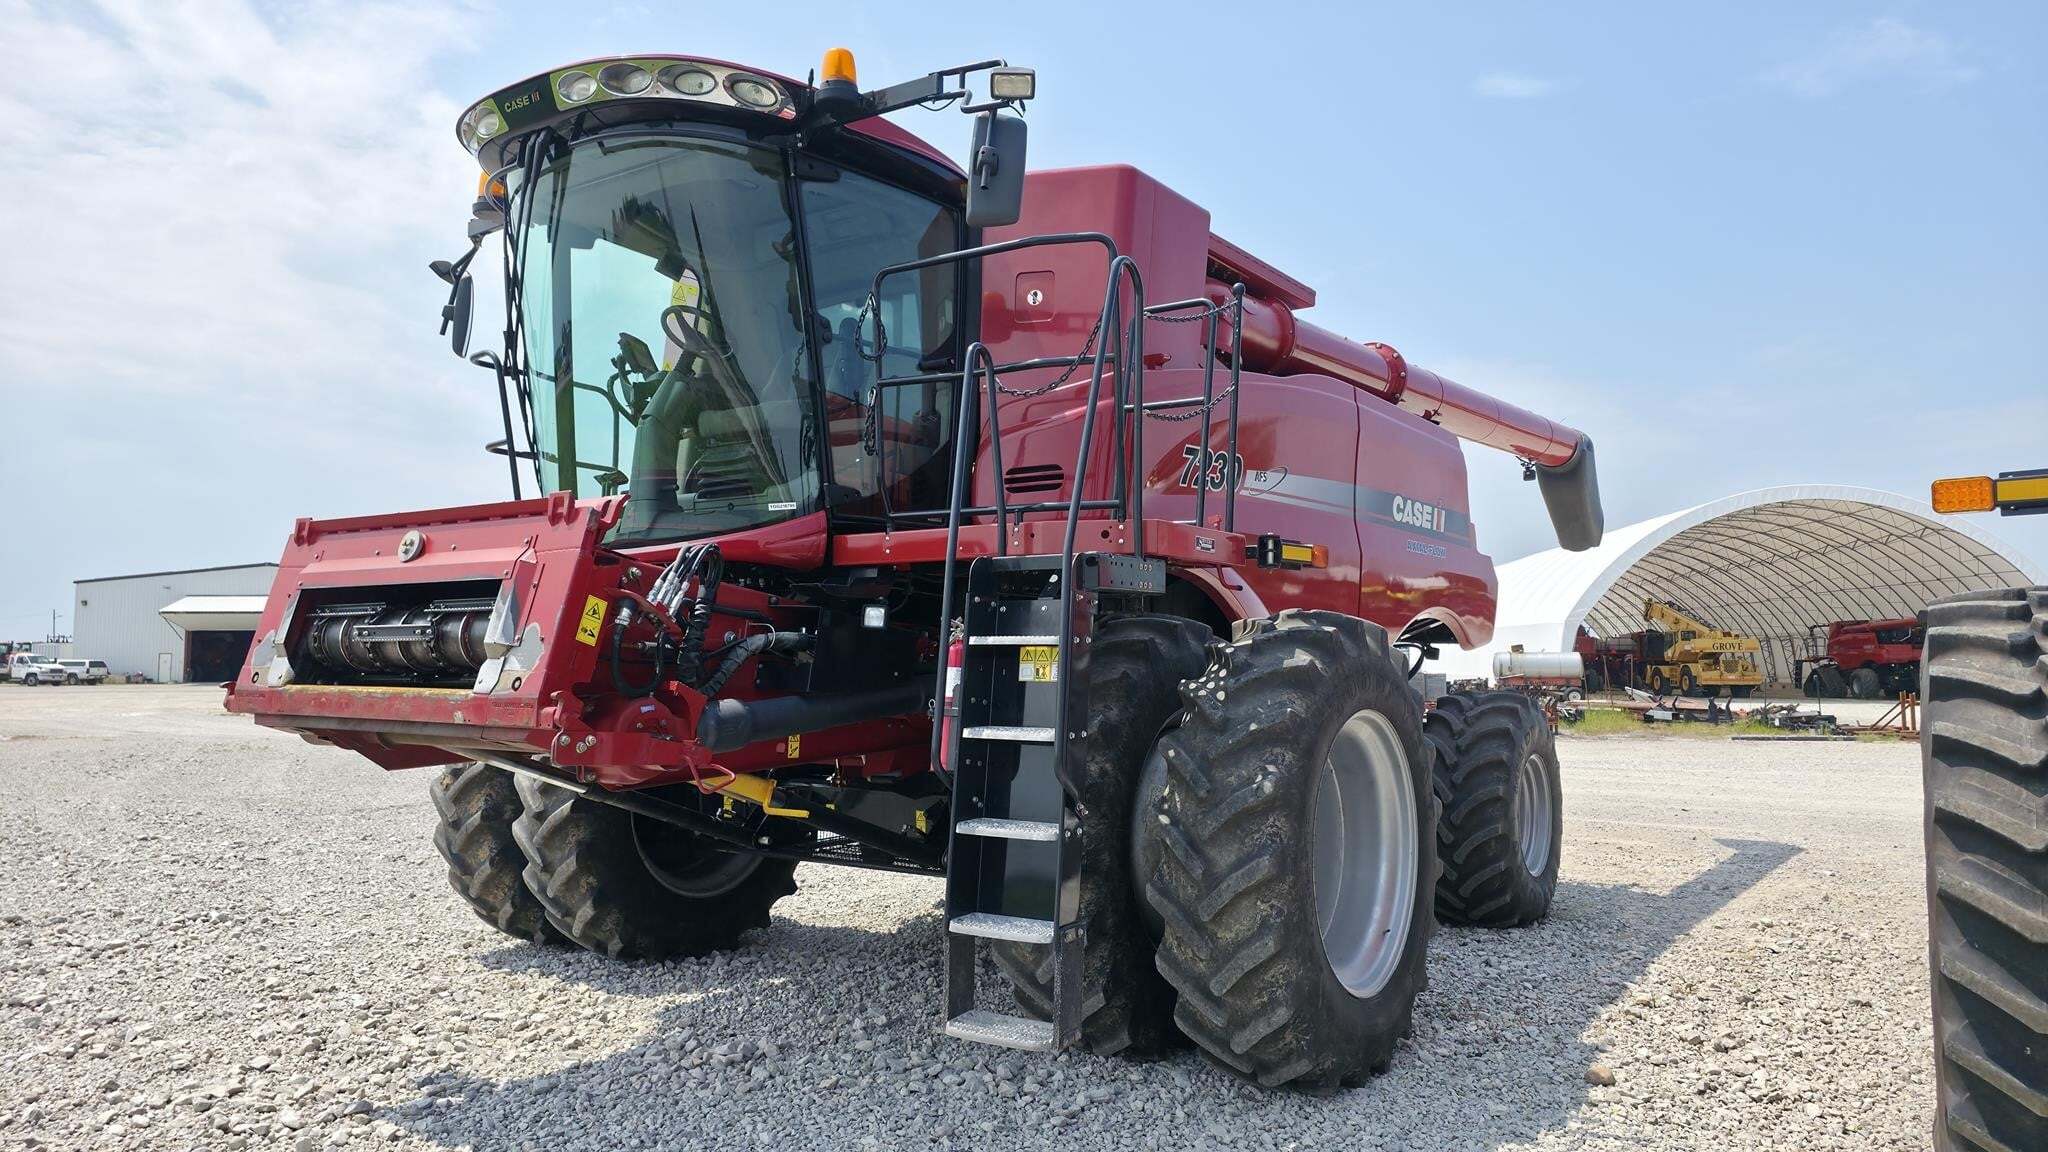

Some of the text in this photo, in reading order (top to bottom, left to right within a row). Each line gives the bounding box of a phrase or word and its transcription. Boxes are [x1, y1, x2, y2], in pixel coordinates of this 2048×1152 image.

[504, 95, 530, 113] CASE
[1254, 471, 1268, 482] AFS
[1392, 495, 1433, 530] CASE
[1712, 642, 1744, 651] GROVE
